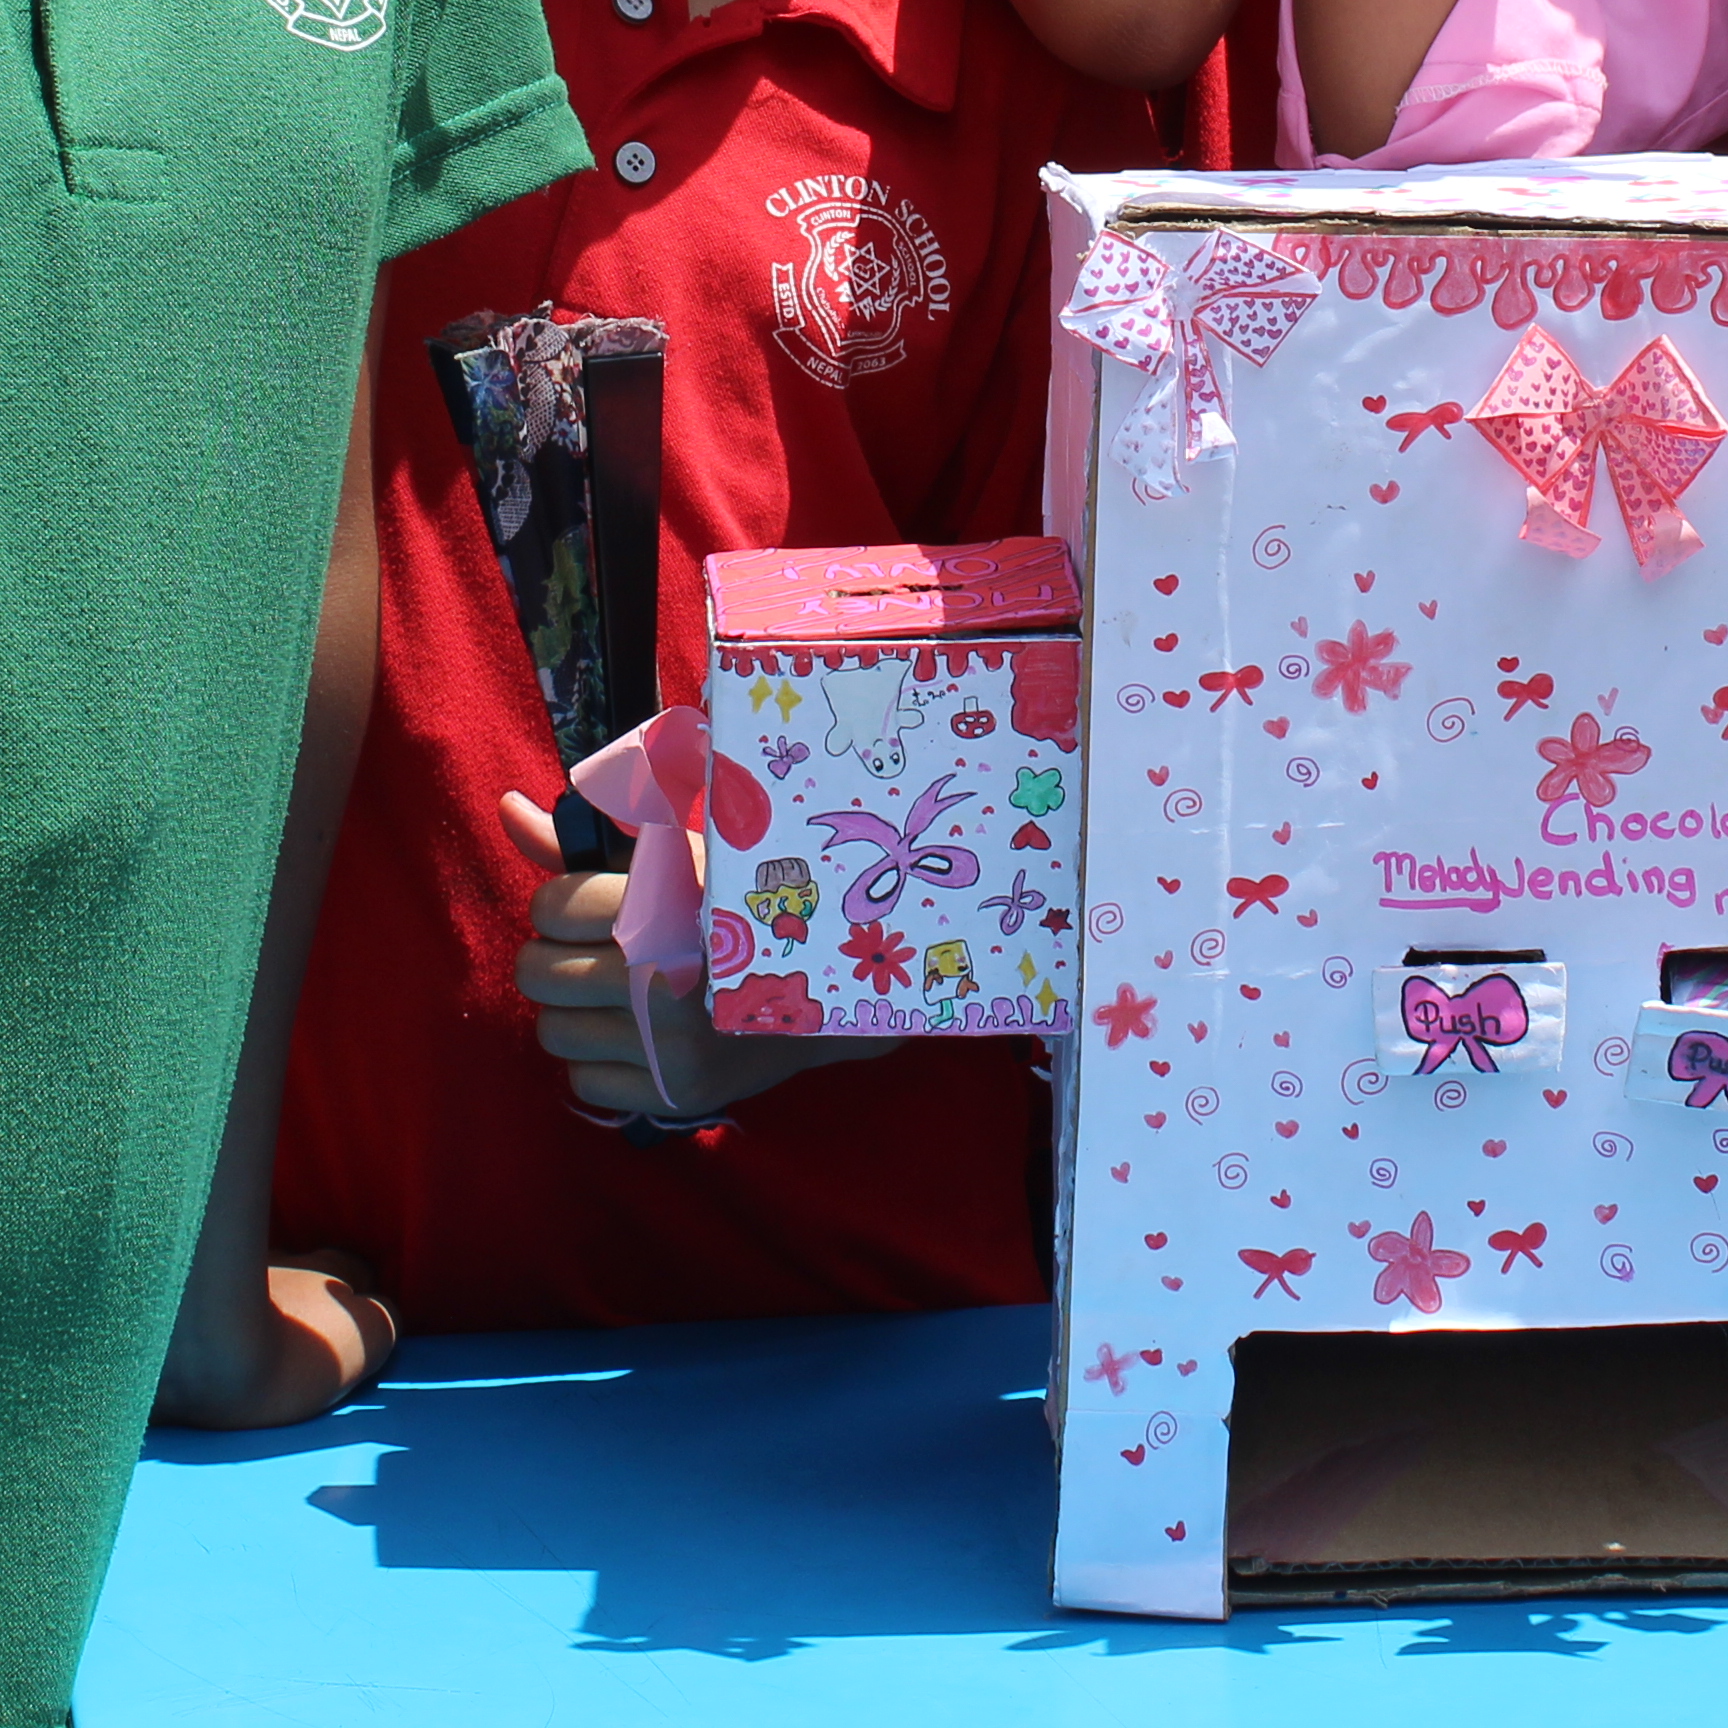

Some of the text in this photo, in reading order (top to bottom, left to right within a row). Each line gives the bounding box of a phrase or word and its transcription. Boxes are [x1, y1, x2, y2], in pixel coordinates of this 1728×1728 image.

[329, 27, 362, 42] NEPAL
[810, 209, 851, 226] CLINTON
[765, 174, 951, 321] CLINTON SCHOOL
[806, 356, 843, 383] NEPAL
[857, 357, 886, 370] 2063
[1414, 999, 1501, 1036] Push
